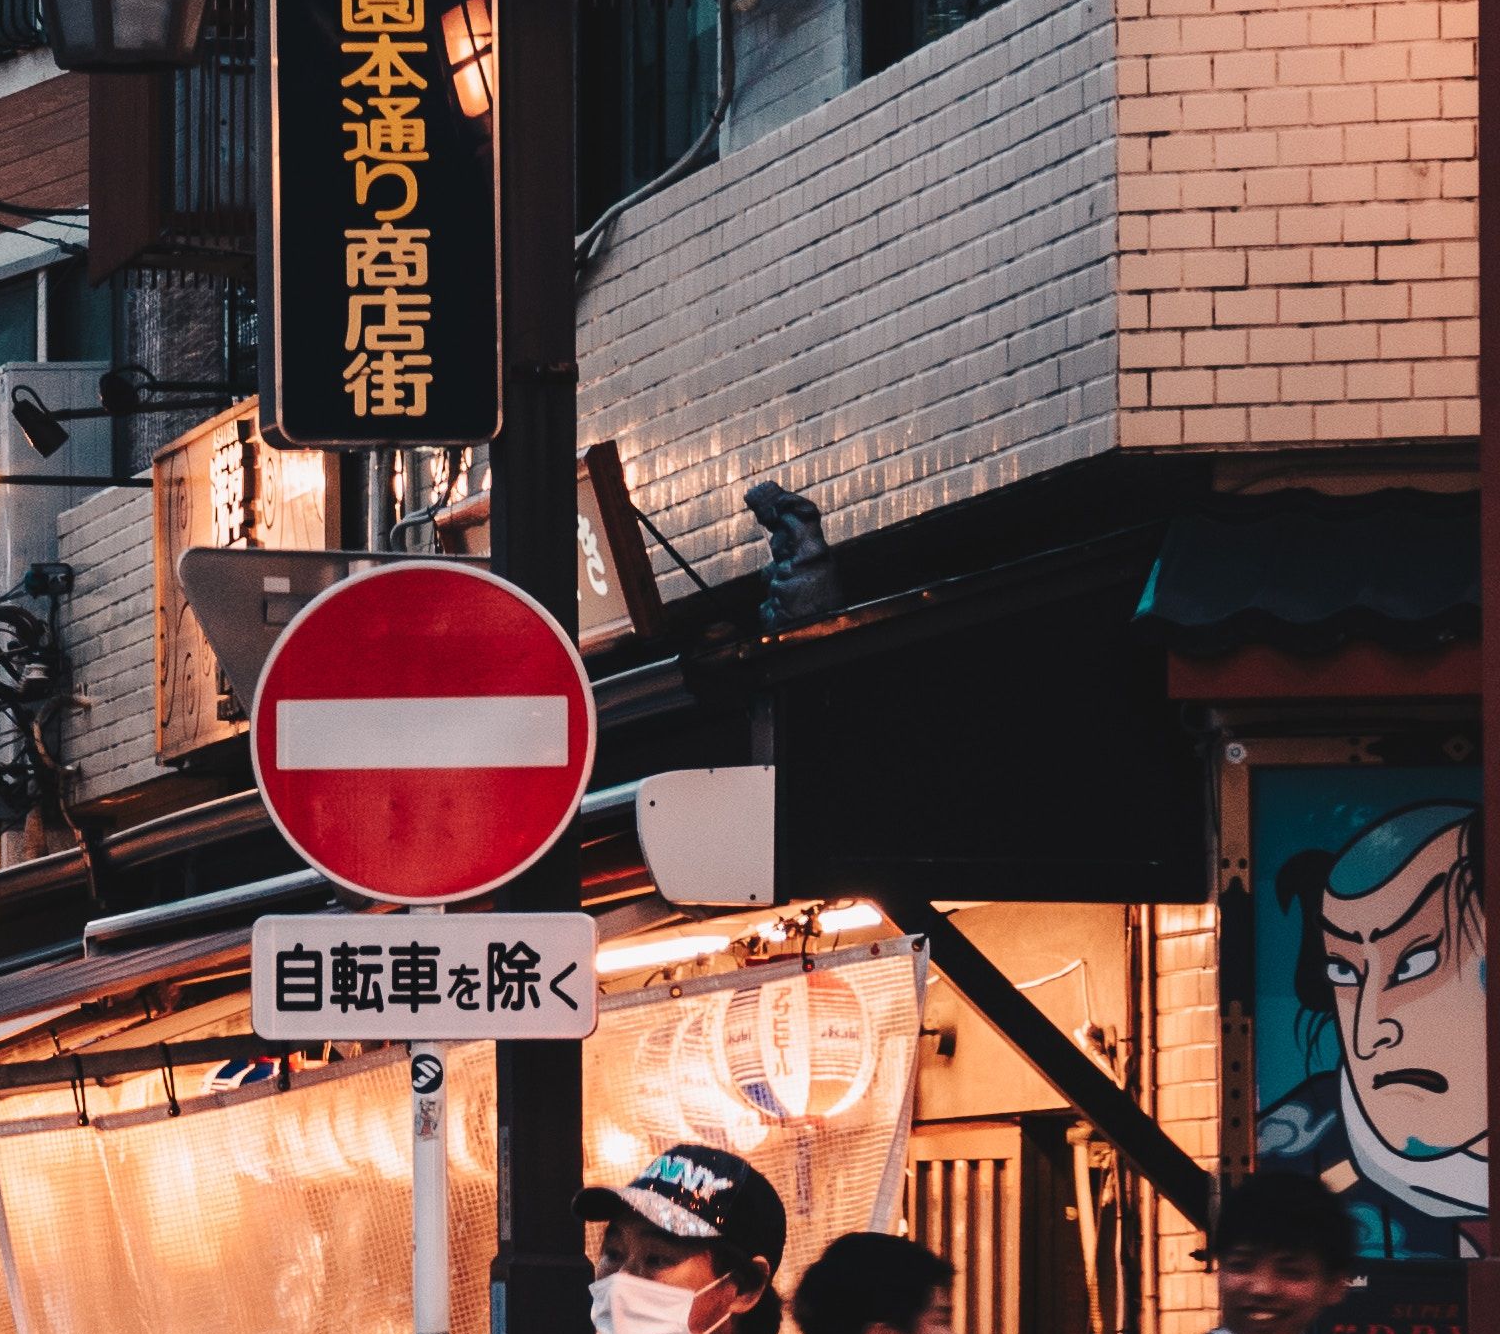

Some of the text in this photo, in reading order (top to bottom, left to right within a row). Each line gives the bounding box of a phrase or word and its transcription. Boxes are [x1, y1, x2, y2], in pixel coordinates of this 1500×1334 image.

[276, 940, 579, 1014] 自転車を除く
